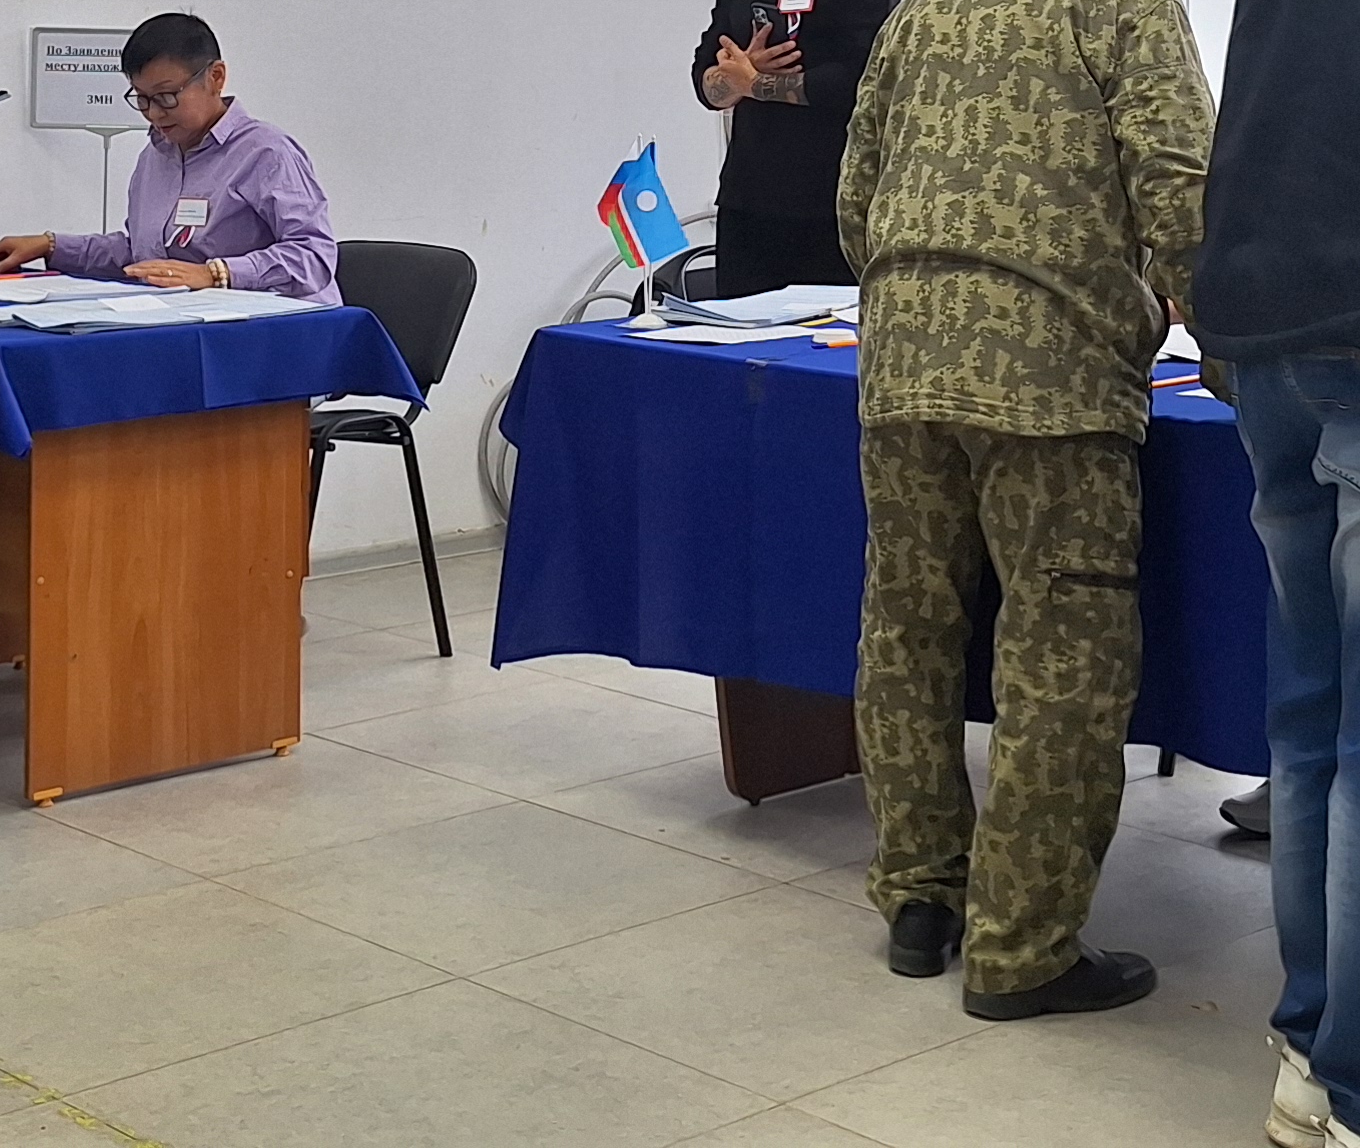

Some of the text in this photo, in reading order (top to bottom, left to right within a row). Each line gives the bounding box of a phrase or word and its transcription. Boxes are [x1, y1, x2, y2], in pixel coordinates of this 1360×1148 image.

[46, 45, 122, 57] По Заявлени
[45, 63, 120, 73] месту нахож
